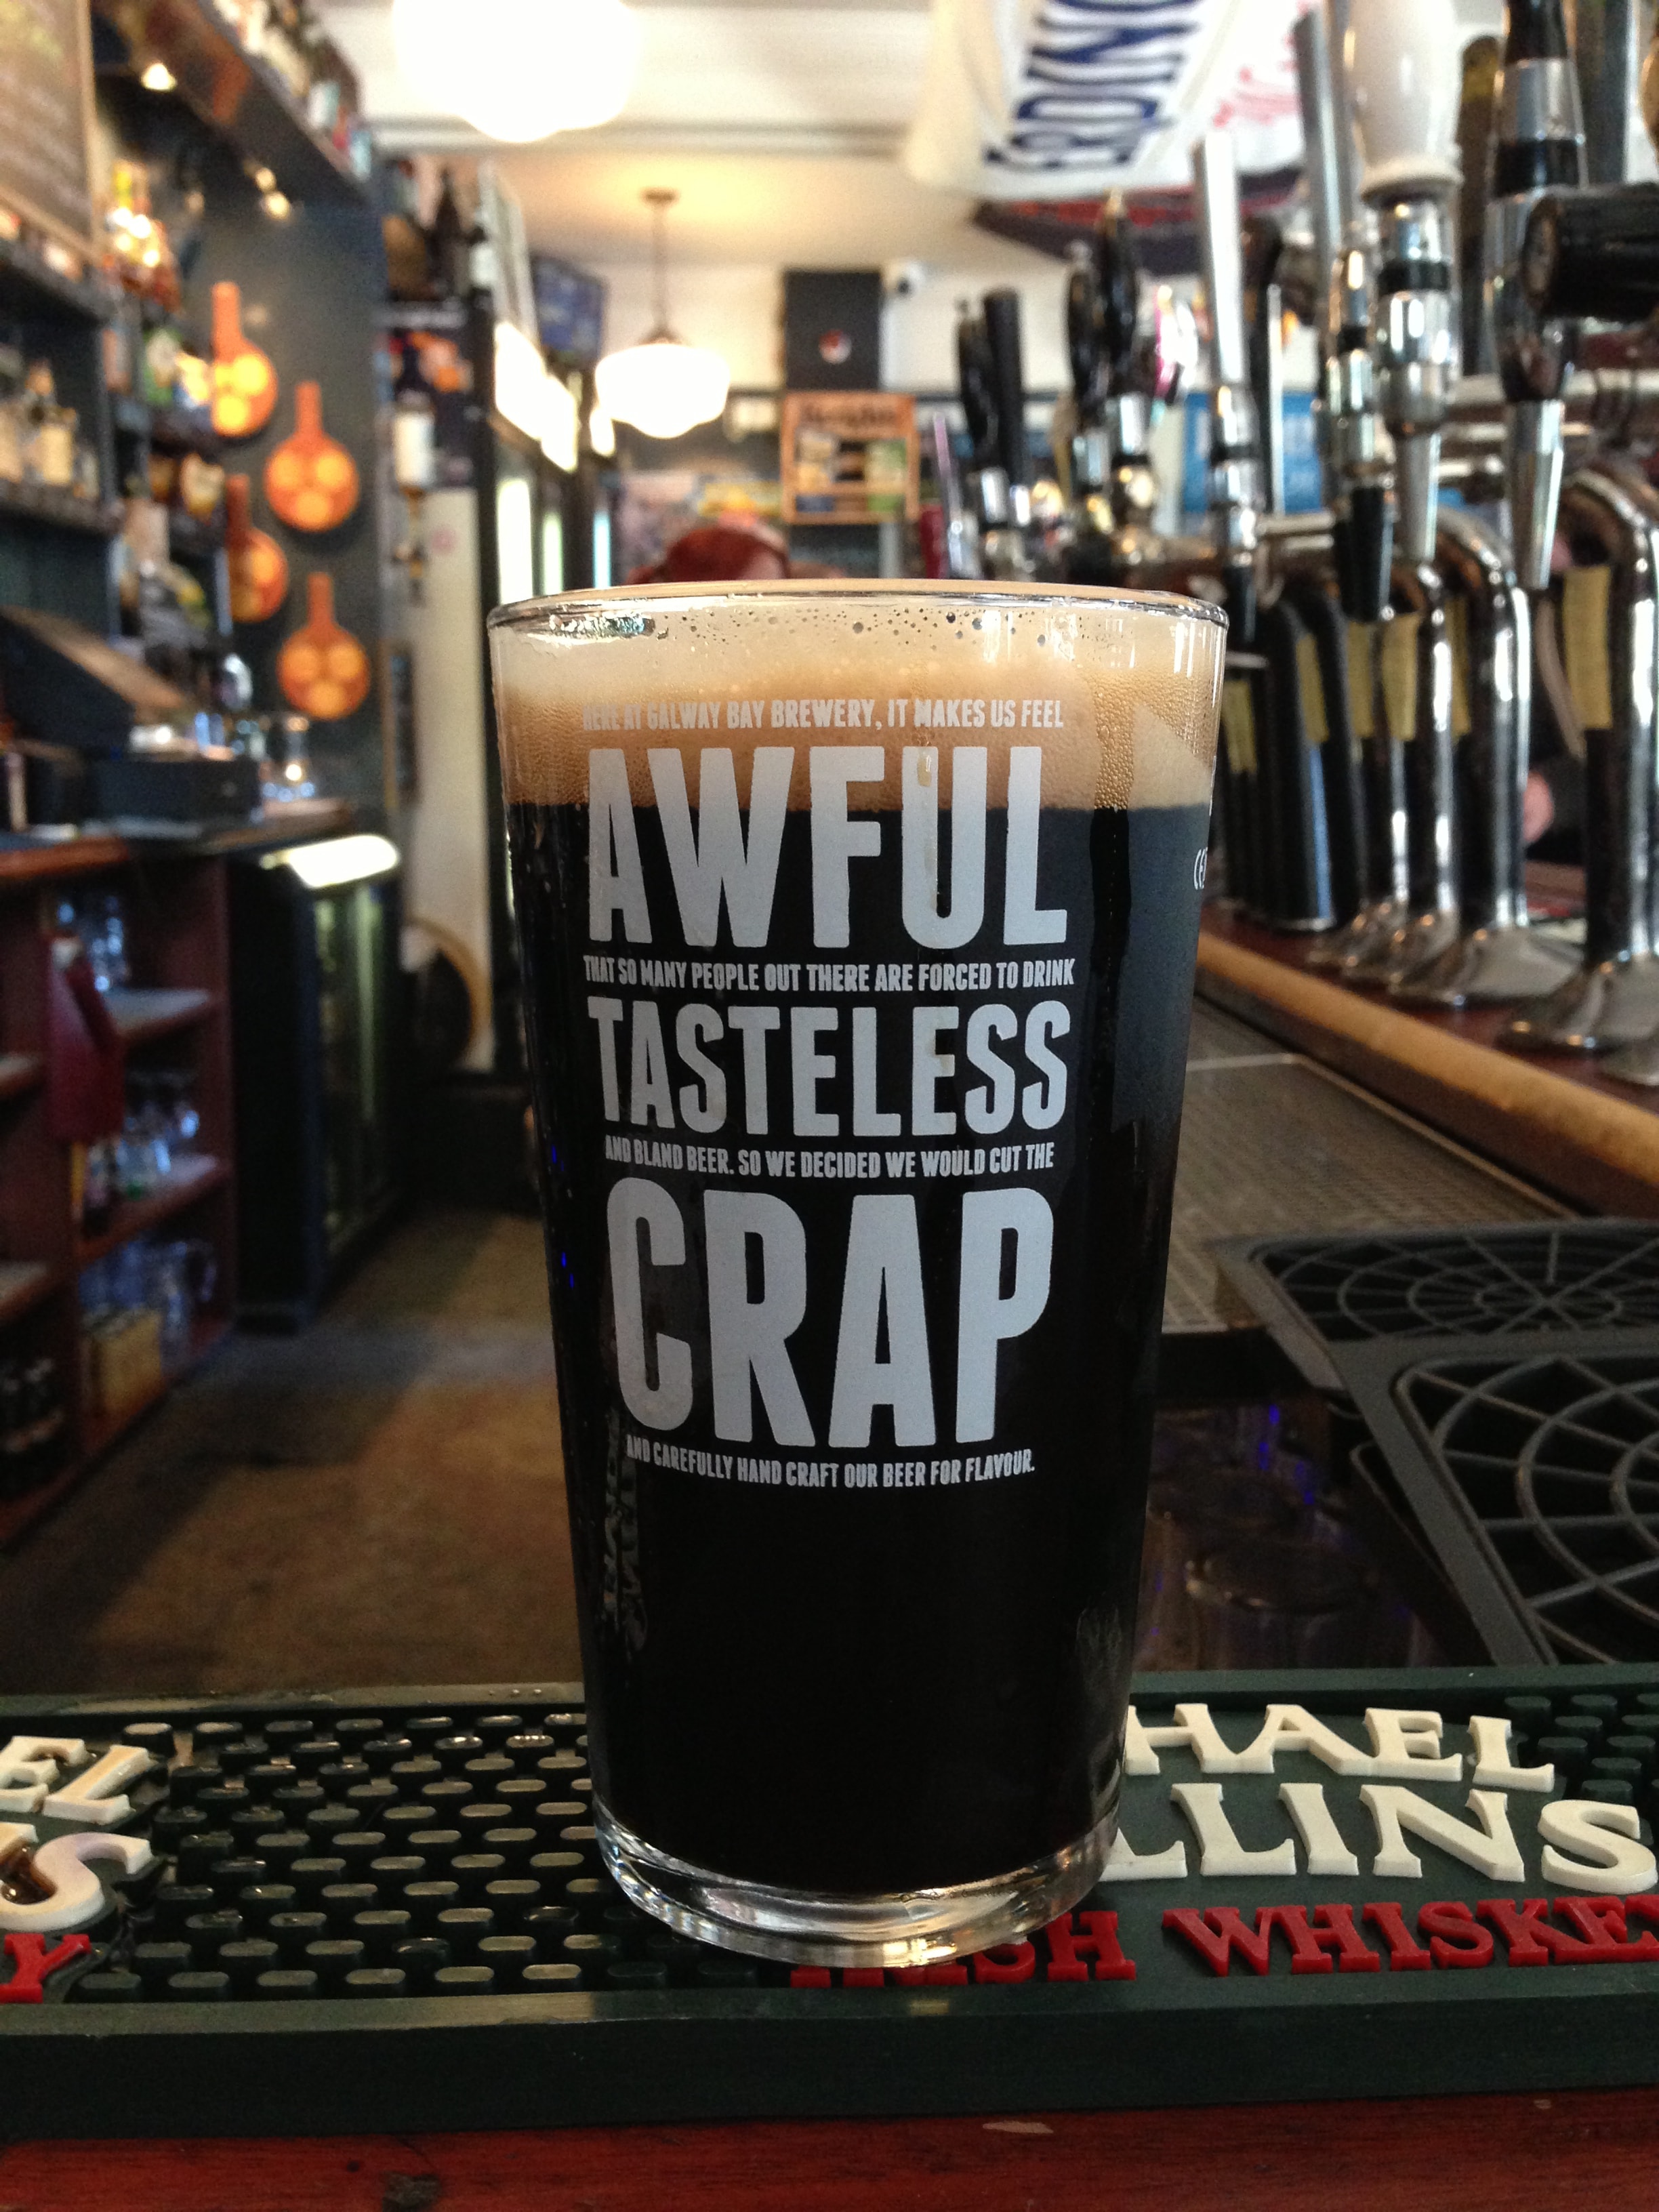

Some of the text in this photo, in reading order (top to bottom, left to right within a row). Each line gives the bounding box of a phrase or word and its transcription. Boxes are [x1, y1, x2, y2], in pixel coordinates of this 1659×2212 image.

[624, 704, 642, 731] AT
[647, 701, 721, 730] GALWAY
[726, 700, 765, 729] BAY
[771, 699, 882, 730] BREWERY,
[888, 699, 908, 727] IT
[914, 699, 985, 728] MAKES
[990, 699, 1016, 728] US
[1021, 699, 1064, 728] FEEL
[588, 746, 1067, 949] AWFUL
[583, 954, 1076, 991] THAT SO MANY PEOPLE OUT THERE ARE FORCED TO DRINK
[588, 996, 1071, 1136] TASTELESS
[605, 1134, 1054, 1179] AND BLAND BEER. SO WE DECIDED WE WOULD CUT THE
[607, 1176, 1054, 1448] CRAP
[626, 1433, 1035, 1488] AND CAREFULLY HAND CRAFT OUR BEER FOR FLAVOUR.
[1122, 1702, 1555, 1793] HAEL
[0, 1821, 154, 1932] S
